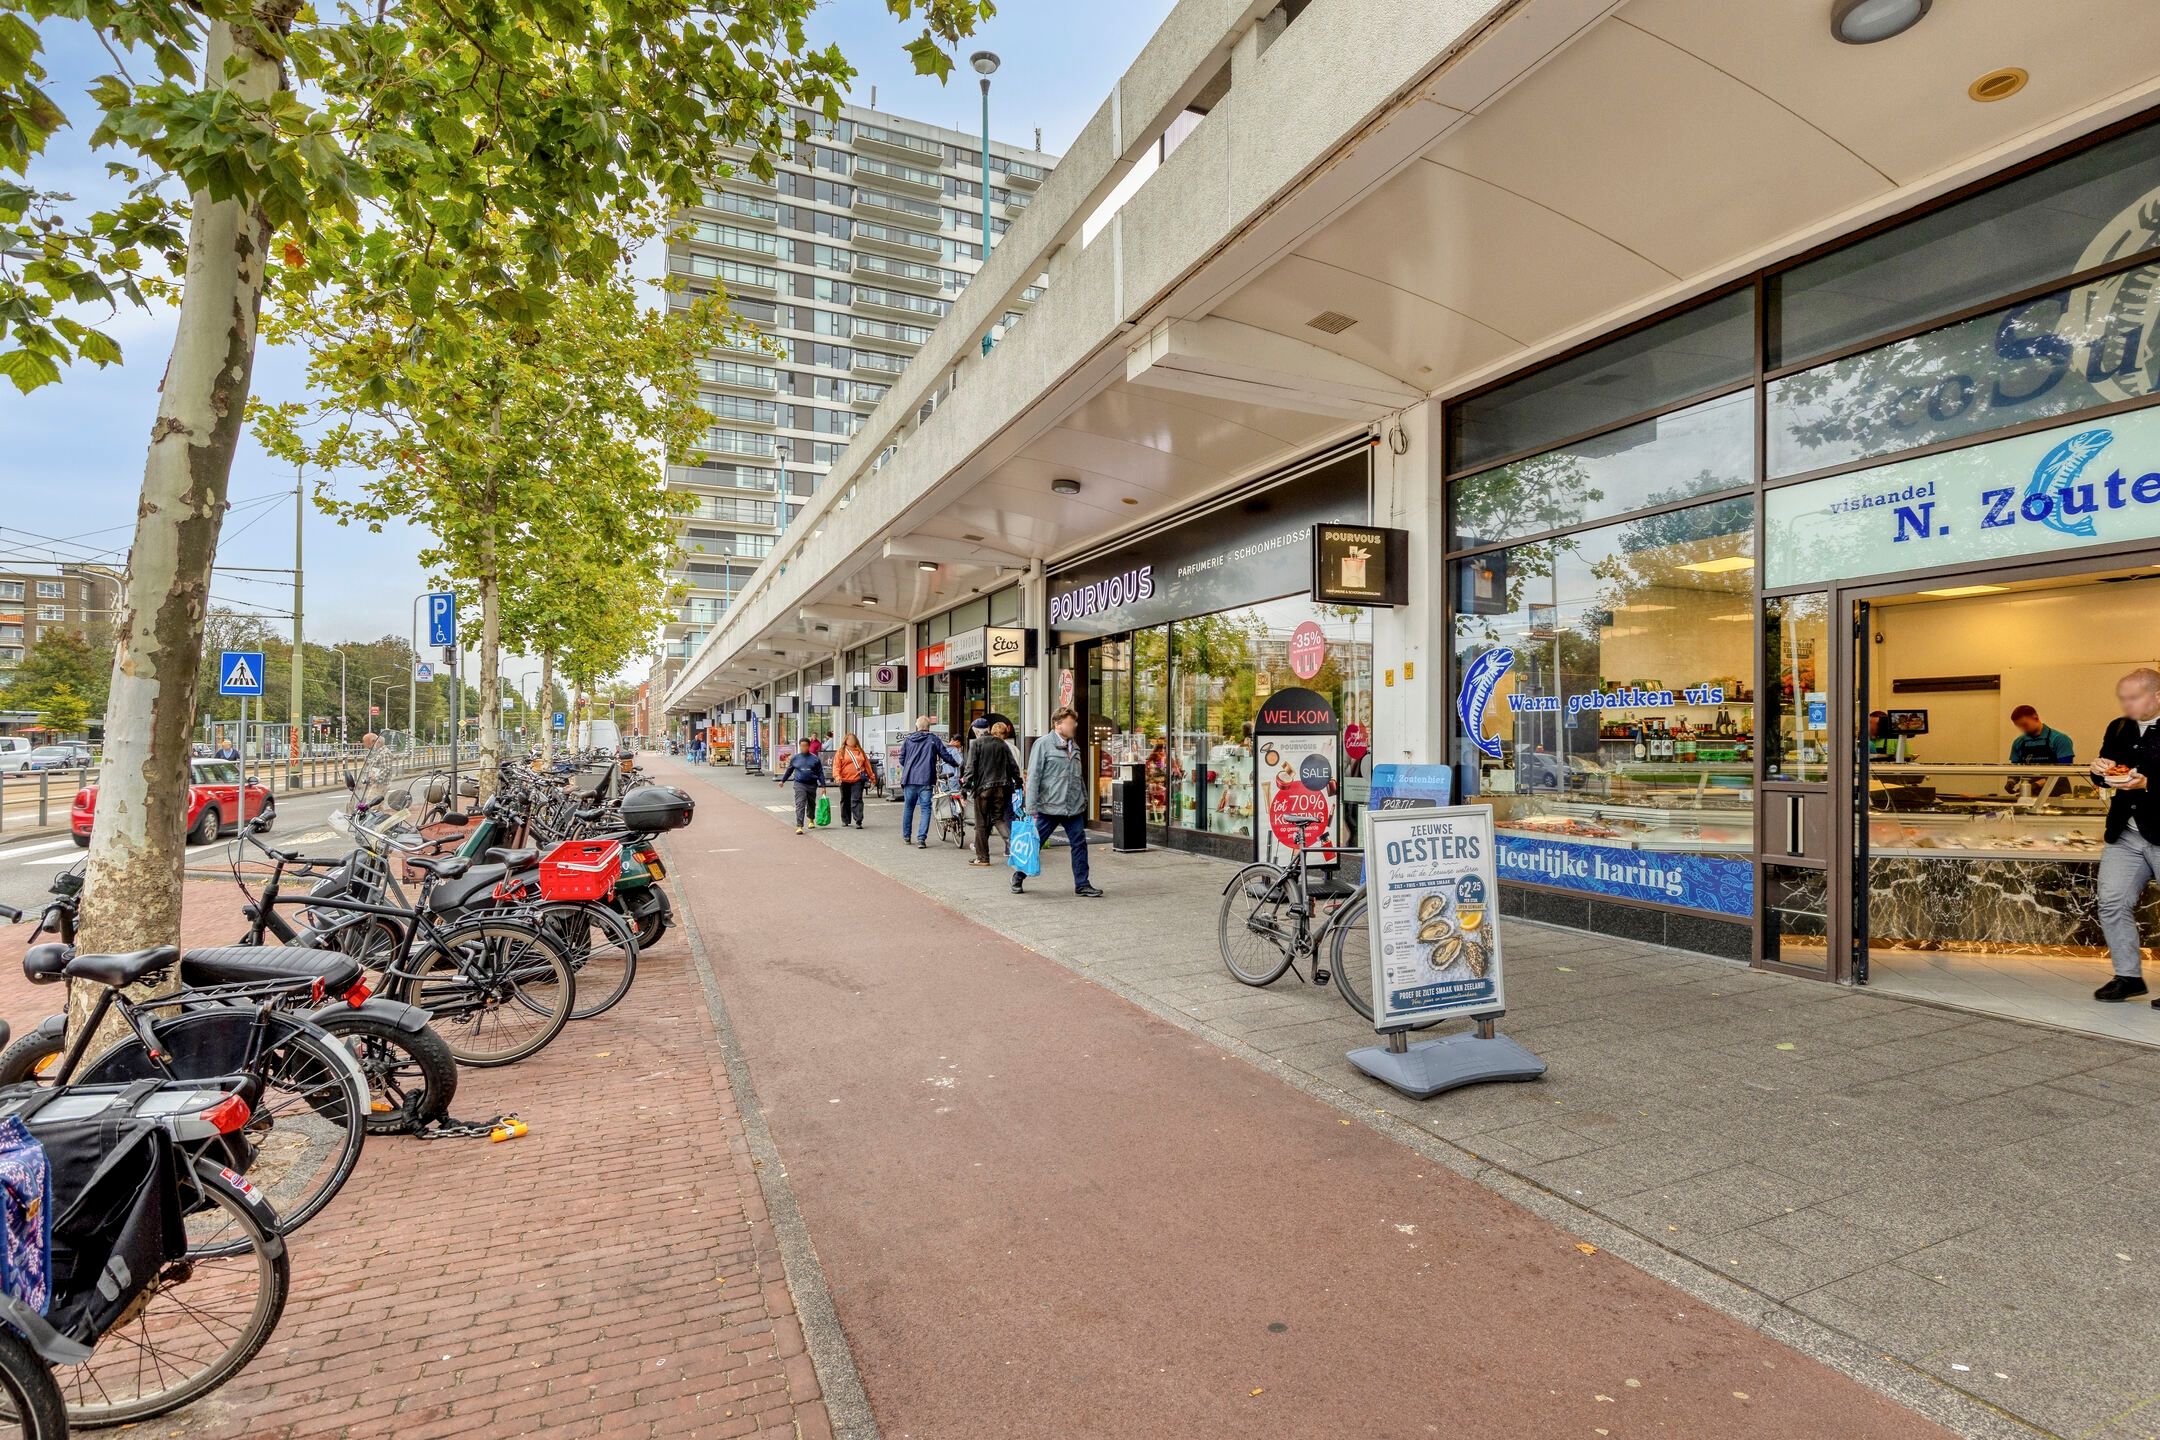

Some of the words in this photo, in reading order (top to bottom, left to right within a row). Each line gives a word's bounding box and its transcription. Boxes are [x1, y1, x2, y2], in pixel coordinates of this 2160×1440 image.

[1830, 481, 1935, 515] vishandel
[1892, 502, 1950, 543] N.
[1325, 532, 1381, 544] POURVOUS
[1178, 555, 1224, 577] PARFUMERIE
[1050, 566, 1154, 624] POURVOUS
[434, 598, 447, 624] P
[993, 635, 1019, 651] Etos
[1293, 631, 1321, 649] -35%
[880, 670, 890, 681] N
[1508, 694, 1560, 712] Warm
[1569, 687, 1673, 713] gebakken
[1685, 684, 1723, 706] vis
[556, 714, 562, 722] P
[1265, 710, 1329, 724] WELKOM
[1280, 743, 1317, 752] POURVOUS
[1302, 768, 1329, 778] SALE
[1386, 775, 1396, 783] N.
[1399, 775, 1446, 784] Zoutenbier
[1273, 801, 1288, 811] tot
[1289, 794, 1325, 811] 70%
[1411, 824, 1453, 837] ZEEUWSE
[1387, 836, 1480, 865] OESTERS
[1494, 845, 1588, 878] Heerlijke
[1595, 855, 1683, 896] haring
[1459, 881, 1481, 898] €2.25
[1400, 991, 1414, 1000] PROEF
[1415, 990, 1422, 998] DE
[1422, 988, 1435, 996] ZILTE
[1435, 986, 1453, 995] SMAAK
[1454, 984, 1463, 992] VAN
[1464, 981, 1486, 991] ZEELAND!
